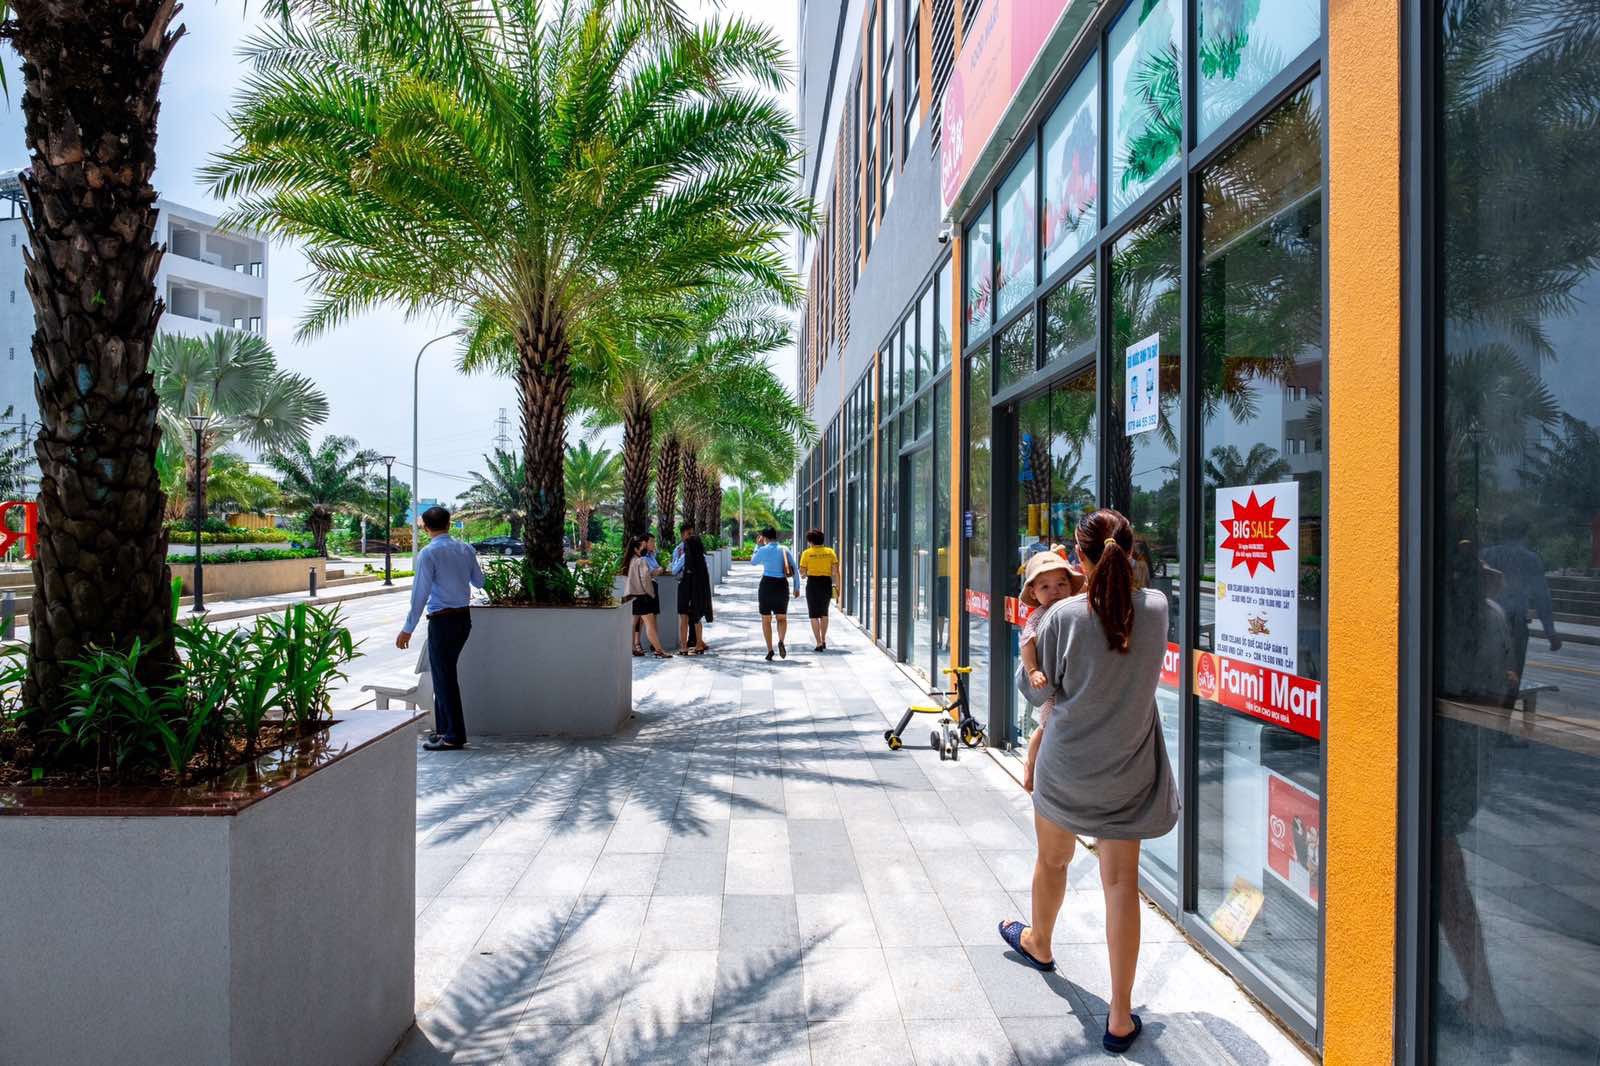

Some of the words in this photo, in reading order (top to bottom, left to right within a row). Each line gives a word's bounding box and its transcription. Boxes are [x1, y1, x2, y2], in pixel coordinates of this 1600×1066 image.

[1232, 519, 1250, 539] BIG
[1250, 520, 1275, 539] SALE
[1220, 658, 1264, 703] Fami
